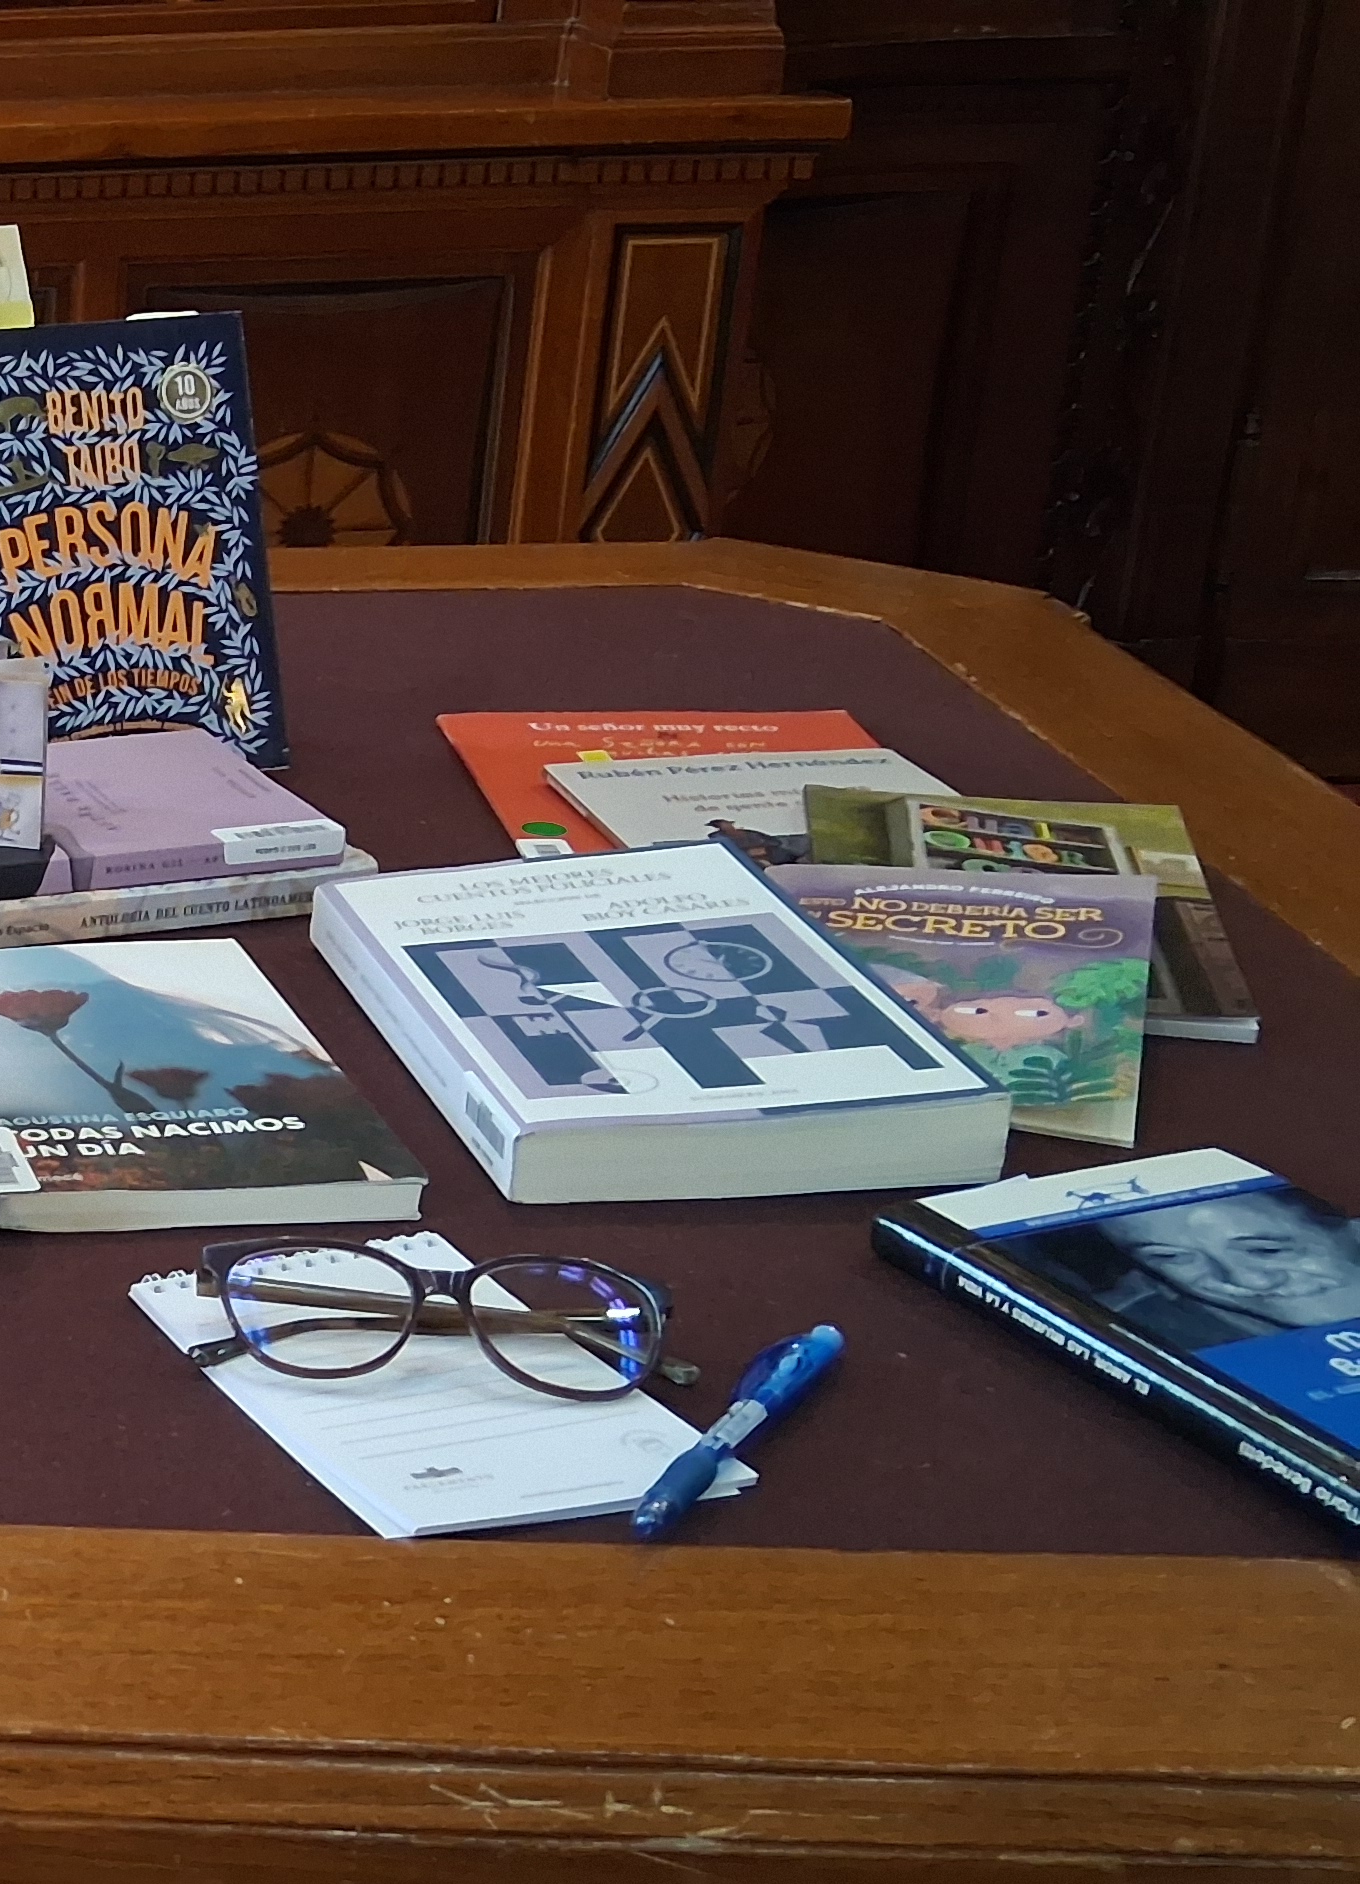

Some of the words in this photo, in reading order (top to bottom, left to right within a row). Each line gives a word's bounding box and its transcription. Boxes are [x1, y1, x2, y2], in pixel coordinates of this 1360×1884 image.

[174, 374, 195, 396] 10
[45, 386, 145, 435] BENITO
[61, 440, 143, 490] TAIBO
[7, 581, 214, 670] NORMAL
[76, 679, 97, 697] DE
[99, 671, 128, 689] LOS
[132, 669, 201, 697] TIEMPOS
[528, 721, 570, 733] Un
[578, 721, 644, 733] señor
[653, 723, 706, 735] muy
[714, 724, 779, 733] recto
[577, 767, 663, 780] Rubén
[667, 762, 742, 776] Pérez
[745, 756, 889, 771] Hernández
[417, 883, 532, 904] CUENTOS
[538, 872, 673, 895] POLICIALES
[460, 878, 504, 892] LOS
[509, 868, 614, 887] MEJORES
[184, 901, 230, 918] CUENTO
[394, 915, 468, 931] JORGE
[473, 909, 527, 923] LUIS
[608, 892, 709, 911] ADOLFO
[420, 921, 515, 937] BORGES
[643, 898, 752, 918] CASARES
[851, 895, 909, 914] NO
[911, 900, 1029, 919] DEBERÍA
[1034, 906, 1104, 923] SER
[826, 909, 1067, 940] SECRETO
[12, 1125, 123, 1142] TODAS
[132, 1116, 306, 1140] NACIMOS
[77, 1139, 146, 1157] DÍA
